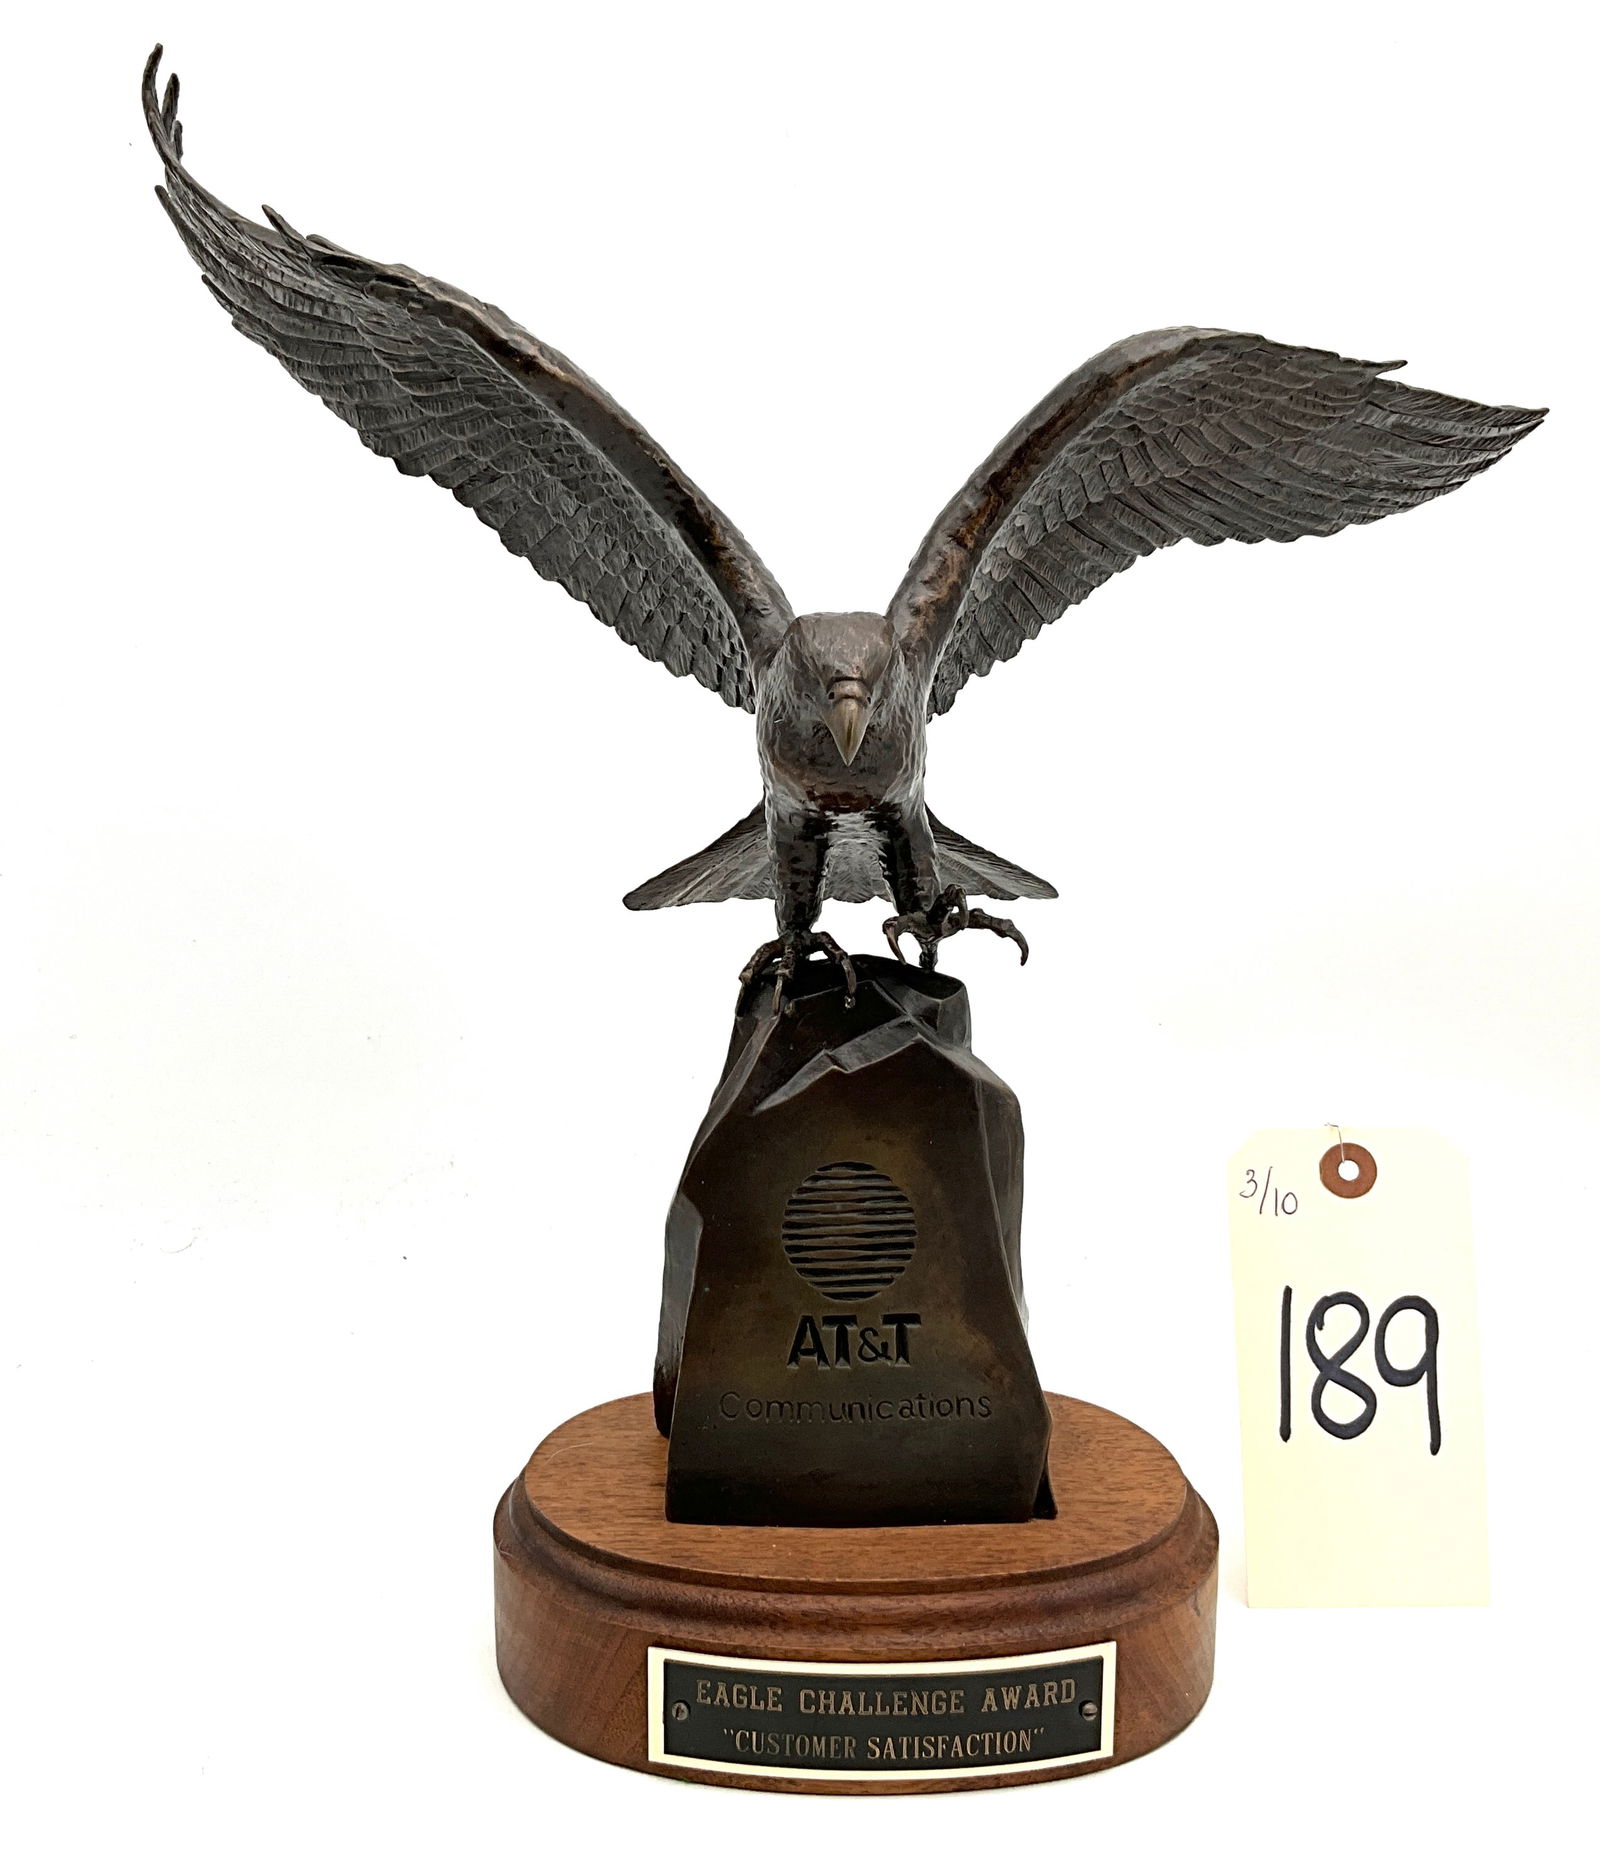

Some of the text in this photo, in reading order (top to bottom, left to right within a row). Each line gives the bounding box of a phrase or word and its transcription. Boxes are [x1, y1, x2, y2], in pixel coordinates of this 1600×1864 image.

[1239, 1166, 1298, 1216] 3/10
[786, 1312, 922, 1370] AT&T
[1279, 1285, 1441, 1456] 189
[719, 1391, 993, 1424] Communications
[696, 1678, 1078, 1717] EAGLE CHALLENGE AWARD
